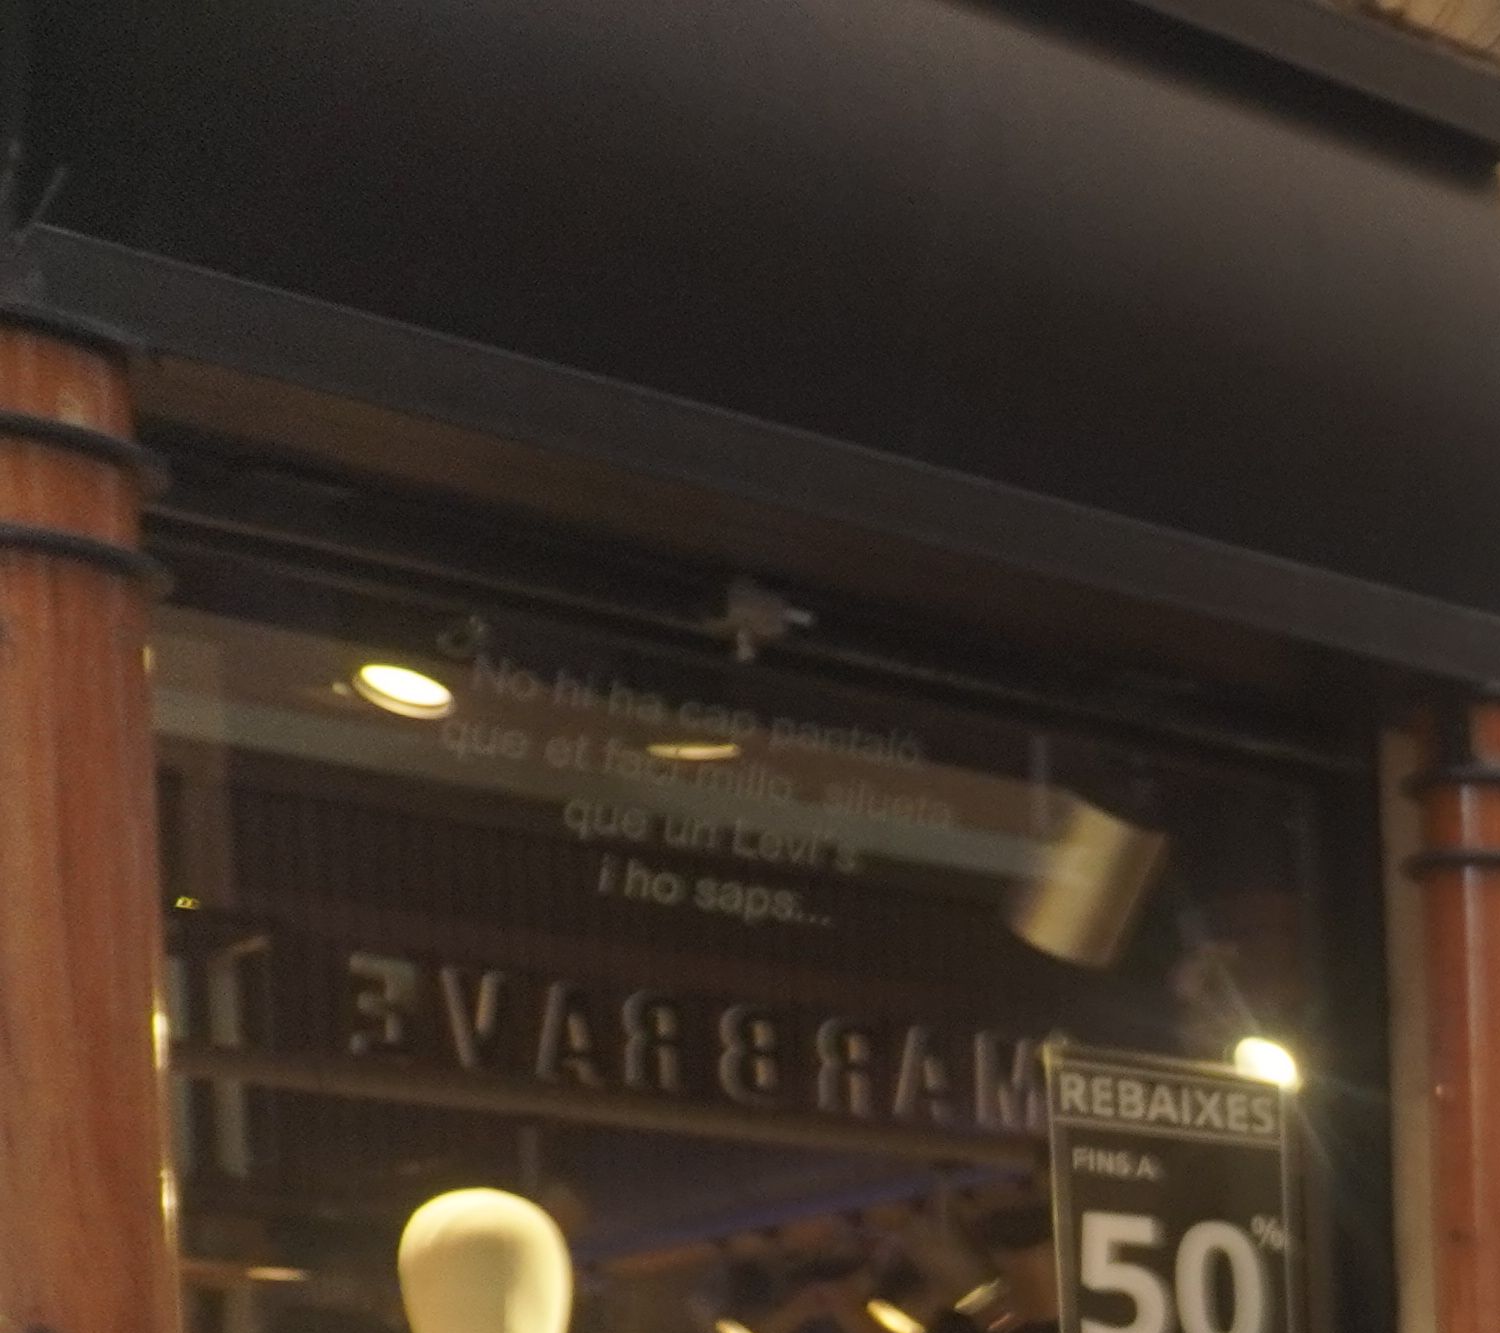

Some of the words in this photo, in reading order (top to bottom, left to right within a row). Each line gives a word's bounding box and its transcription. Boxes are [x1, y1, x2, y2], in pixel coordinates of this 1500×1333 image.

[624, 858, 686, 905] ho
[1058, 1071, 1275, 1136] REBAIXES
[1072, 1146, 1131, 1178] FINS
[1135, 1154, 1159, 1180] A
